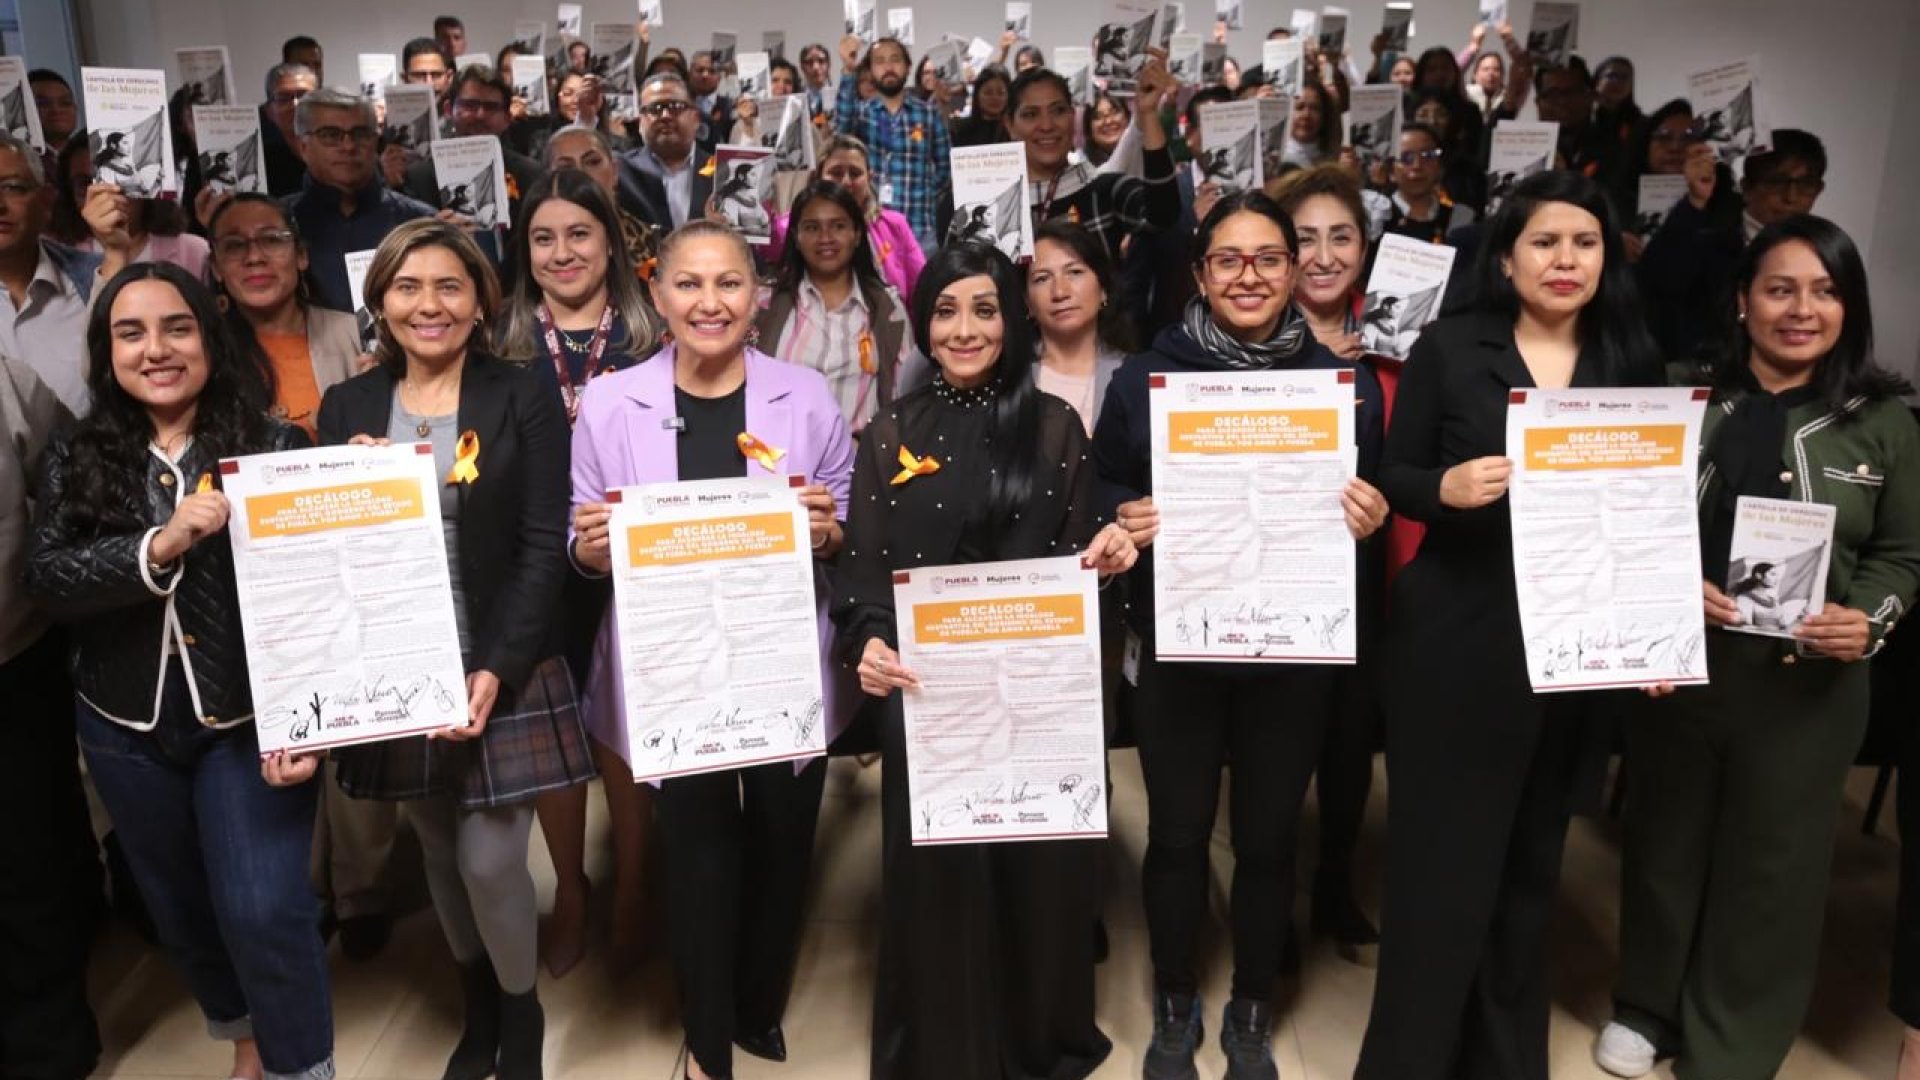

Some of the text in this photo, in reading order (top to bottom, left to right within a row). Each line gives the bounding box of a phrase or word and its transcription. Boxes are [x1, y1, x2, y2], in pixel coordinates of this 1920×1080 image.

[1200, 385, 1276, 394] PUEBLA Mujeres
[1214, 414, 1289, 426] DECÁLOGO
[1568, 430, 1638, 442] DECÁLOGO
[275, 460, 355, 475] PUEBLA Mujeres
[294, 487, 372, 506] DECÁLOGO
[698, 492, 732, 502] Mujeres
[672, 520, 746, 537] DECÁLOGO
[944, 574, 1021, 585] PUEBLA Mujeres
[959, 601, 1034, 615] DECÁLOGO
